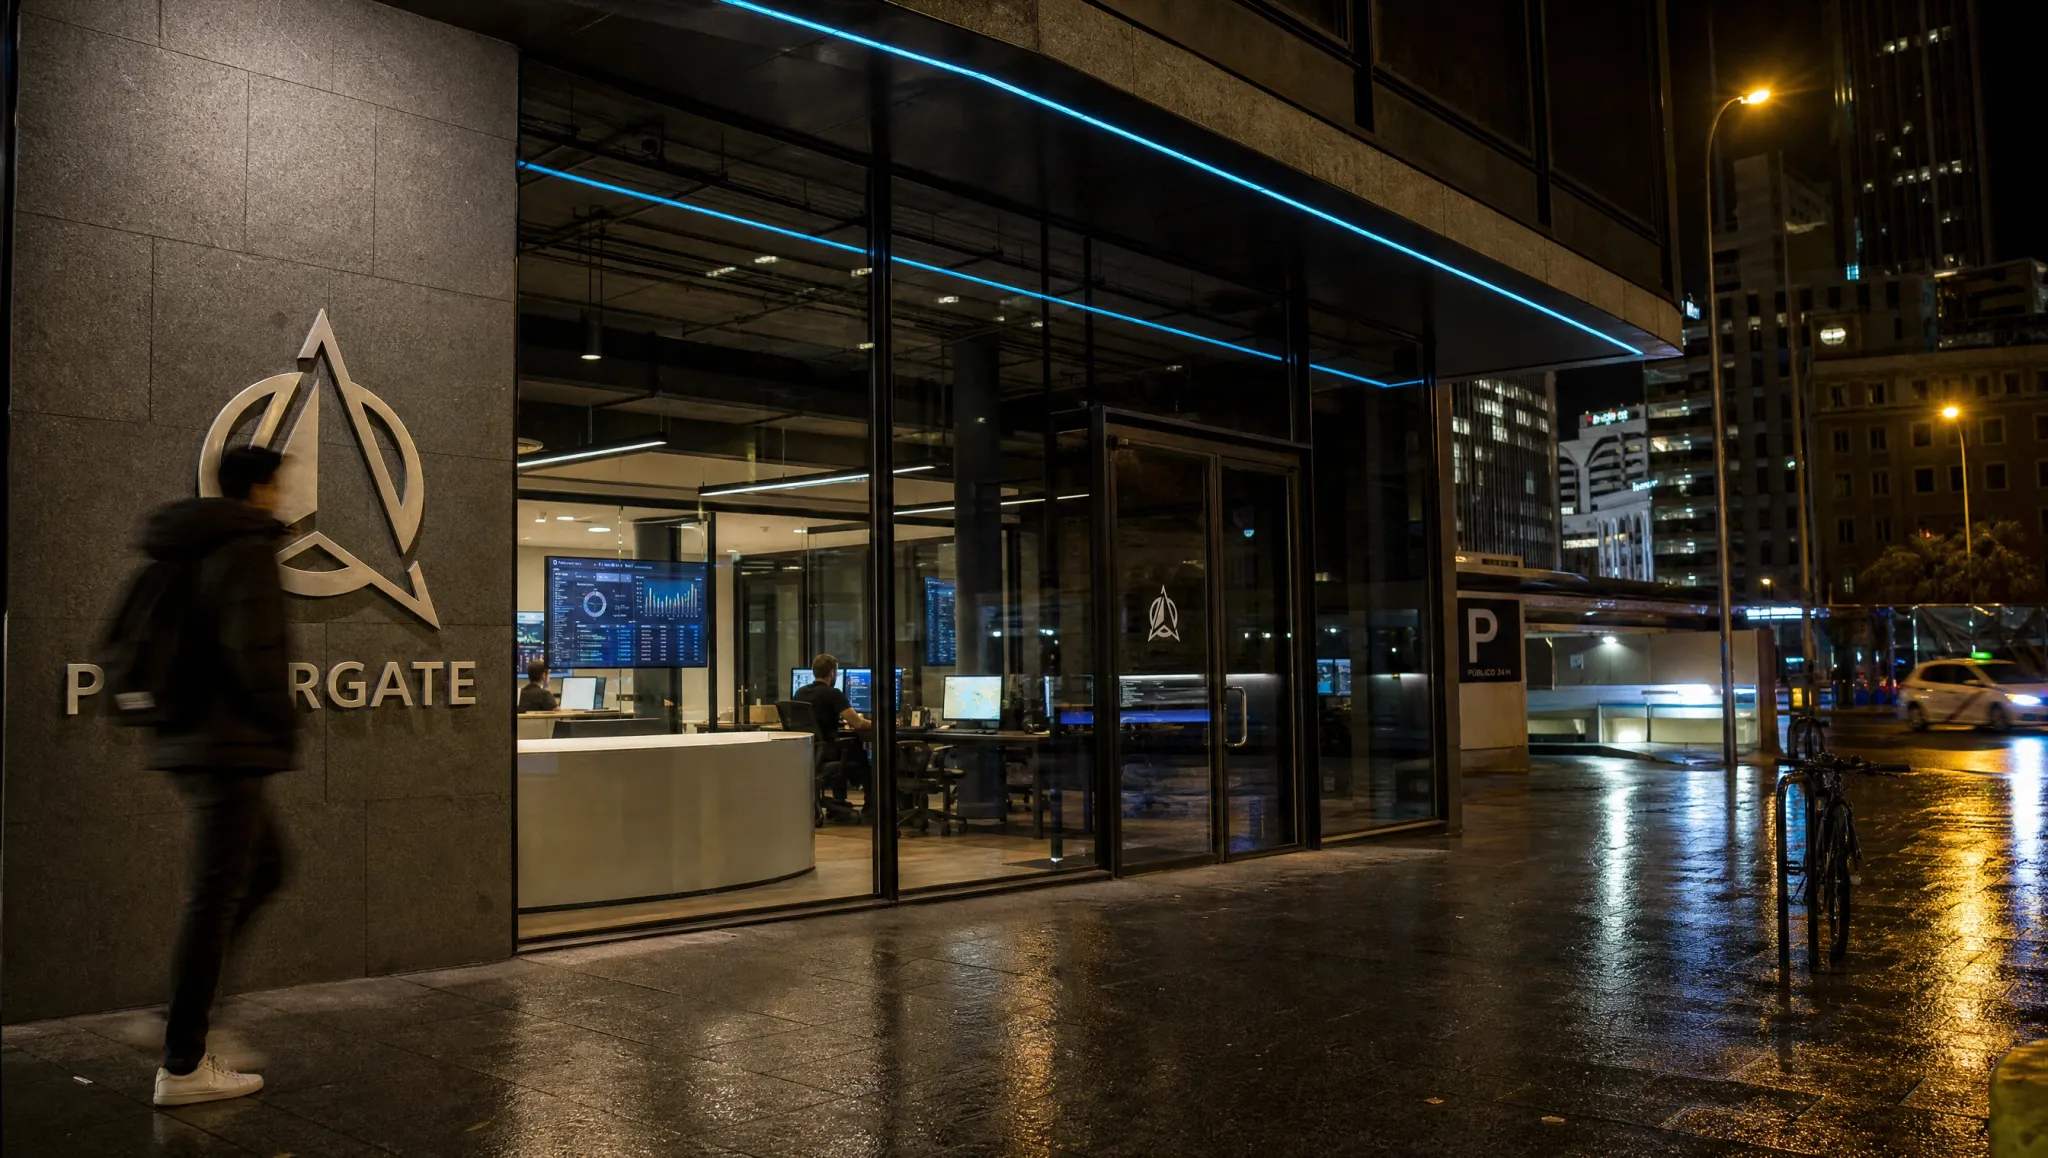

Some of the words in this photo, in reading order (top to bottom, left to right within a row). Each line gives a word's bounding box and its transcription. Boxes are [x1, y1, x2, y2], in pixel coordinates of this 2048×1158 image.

[1467, 608, 1498, 663] P
[1467, 668, 1496, 677] PÚBLICO
[1497, 668, 1505, 676] 24
